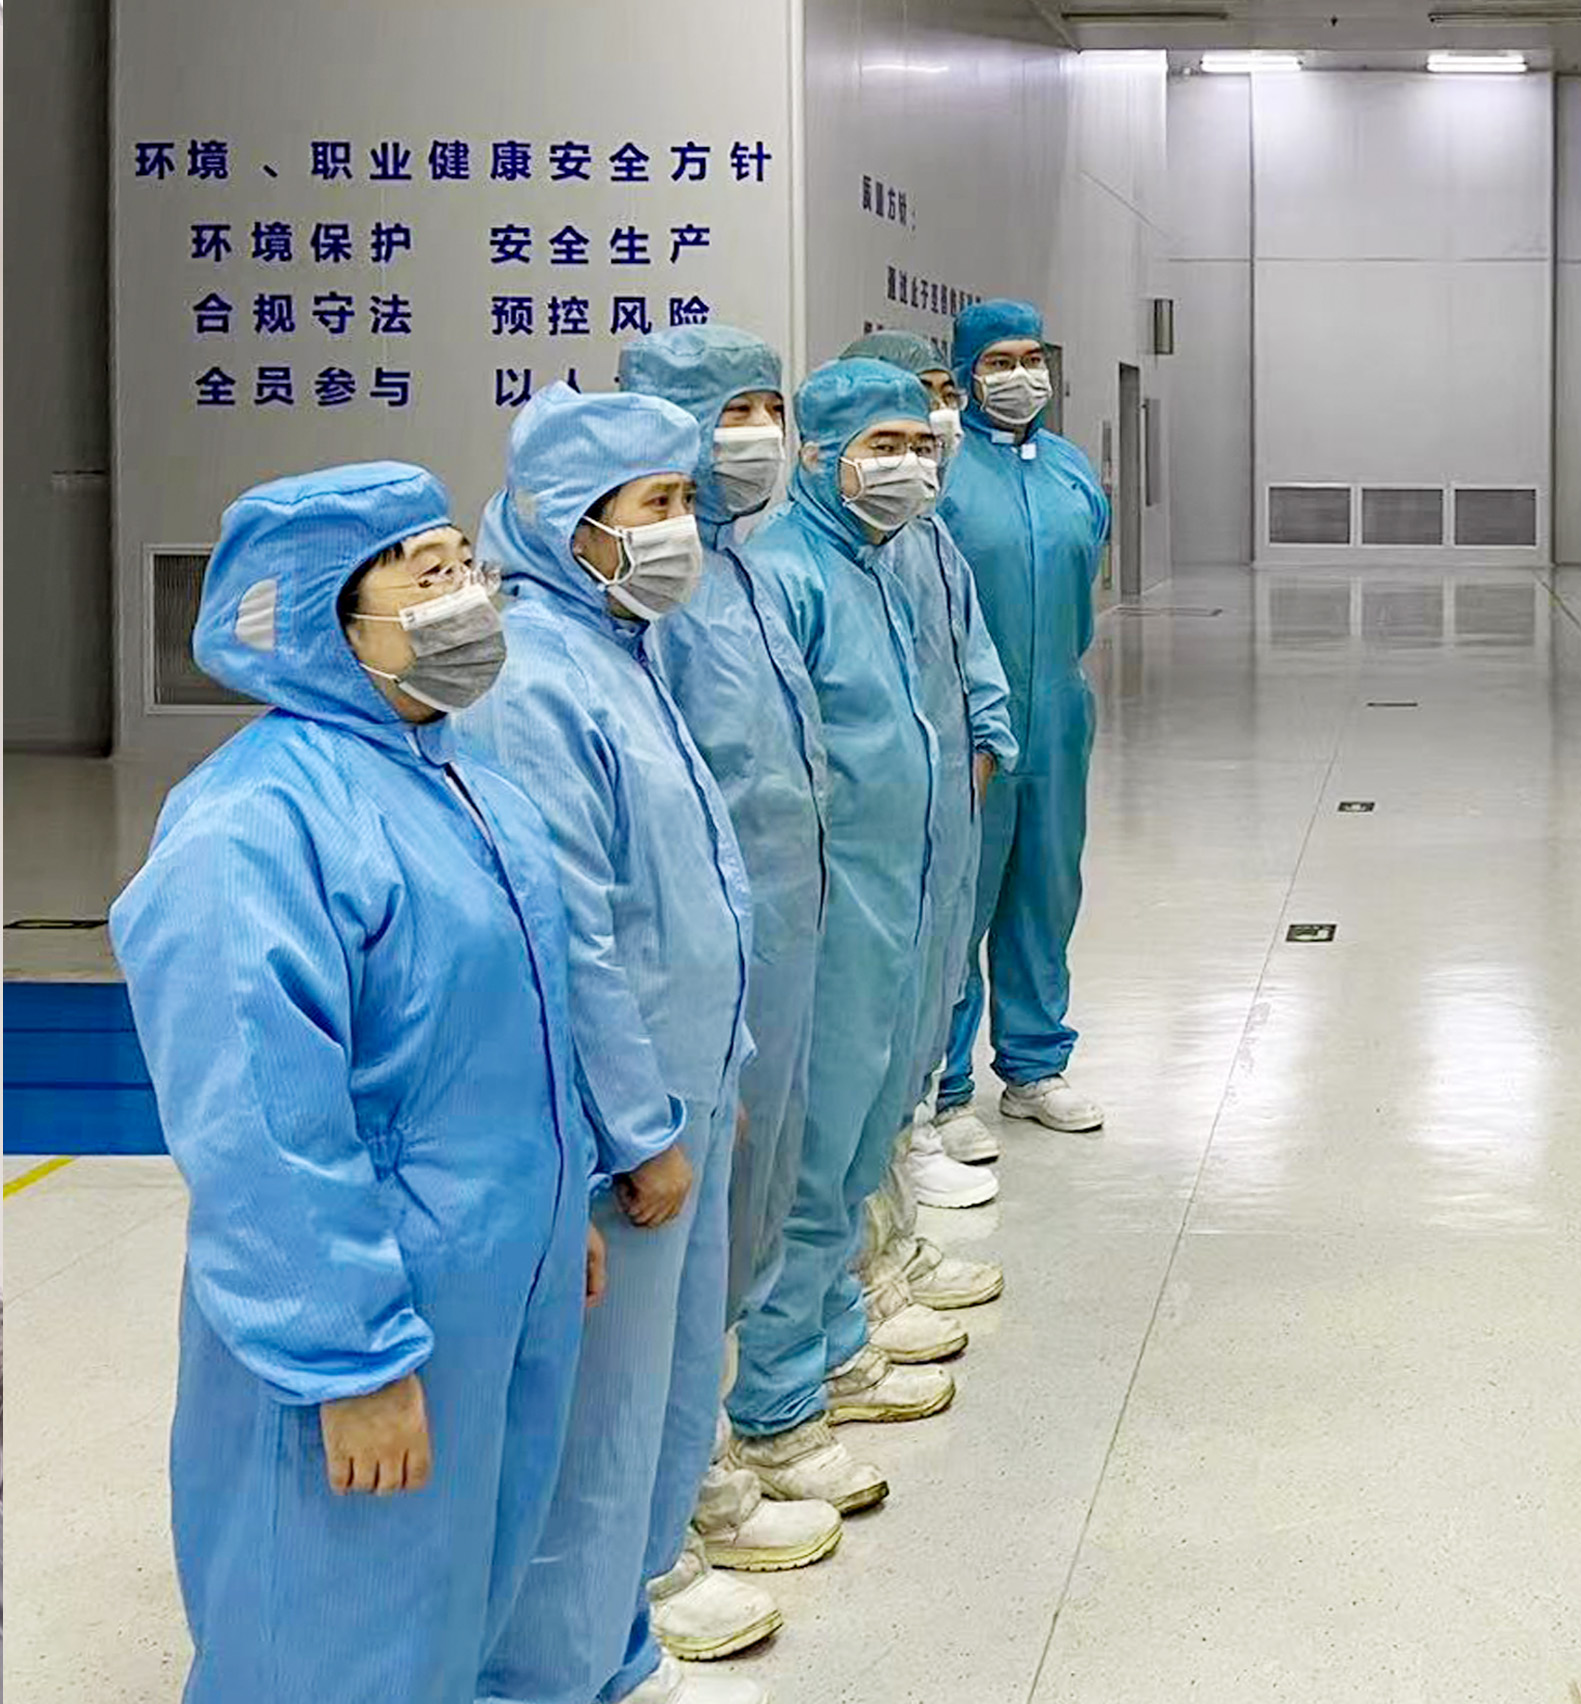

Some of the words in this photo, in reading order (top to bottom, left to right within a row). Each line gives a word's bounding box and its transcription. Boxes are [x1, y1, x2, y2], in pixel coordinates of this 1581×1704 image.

[134, 140, 773, 183] 环境、职业健康安全方针
[190, 222, 413, 265] 环境保护
[489, 223, 713, 265] 安全生产
[192, 293, 413, 336] 合规守法
[491, 294, 712, 336] 预控风险
[195, 366, 412, 407] 全员参与
